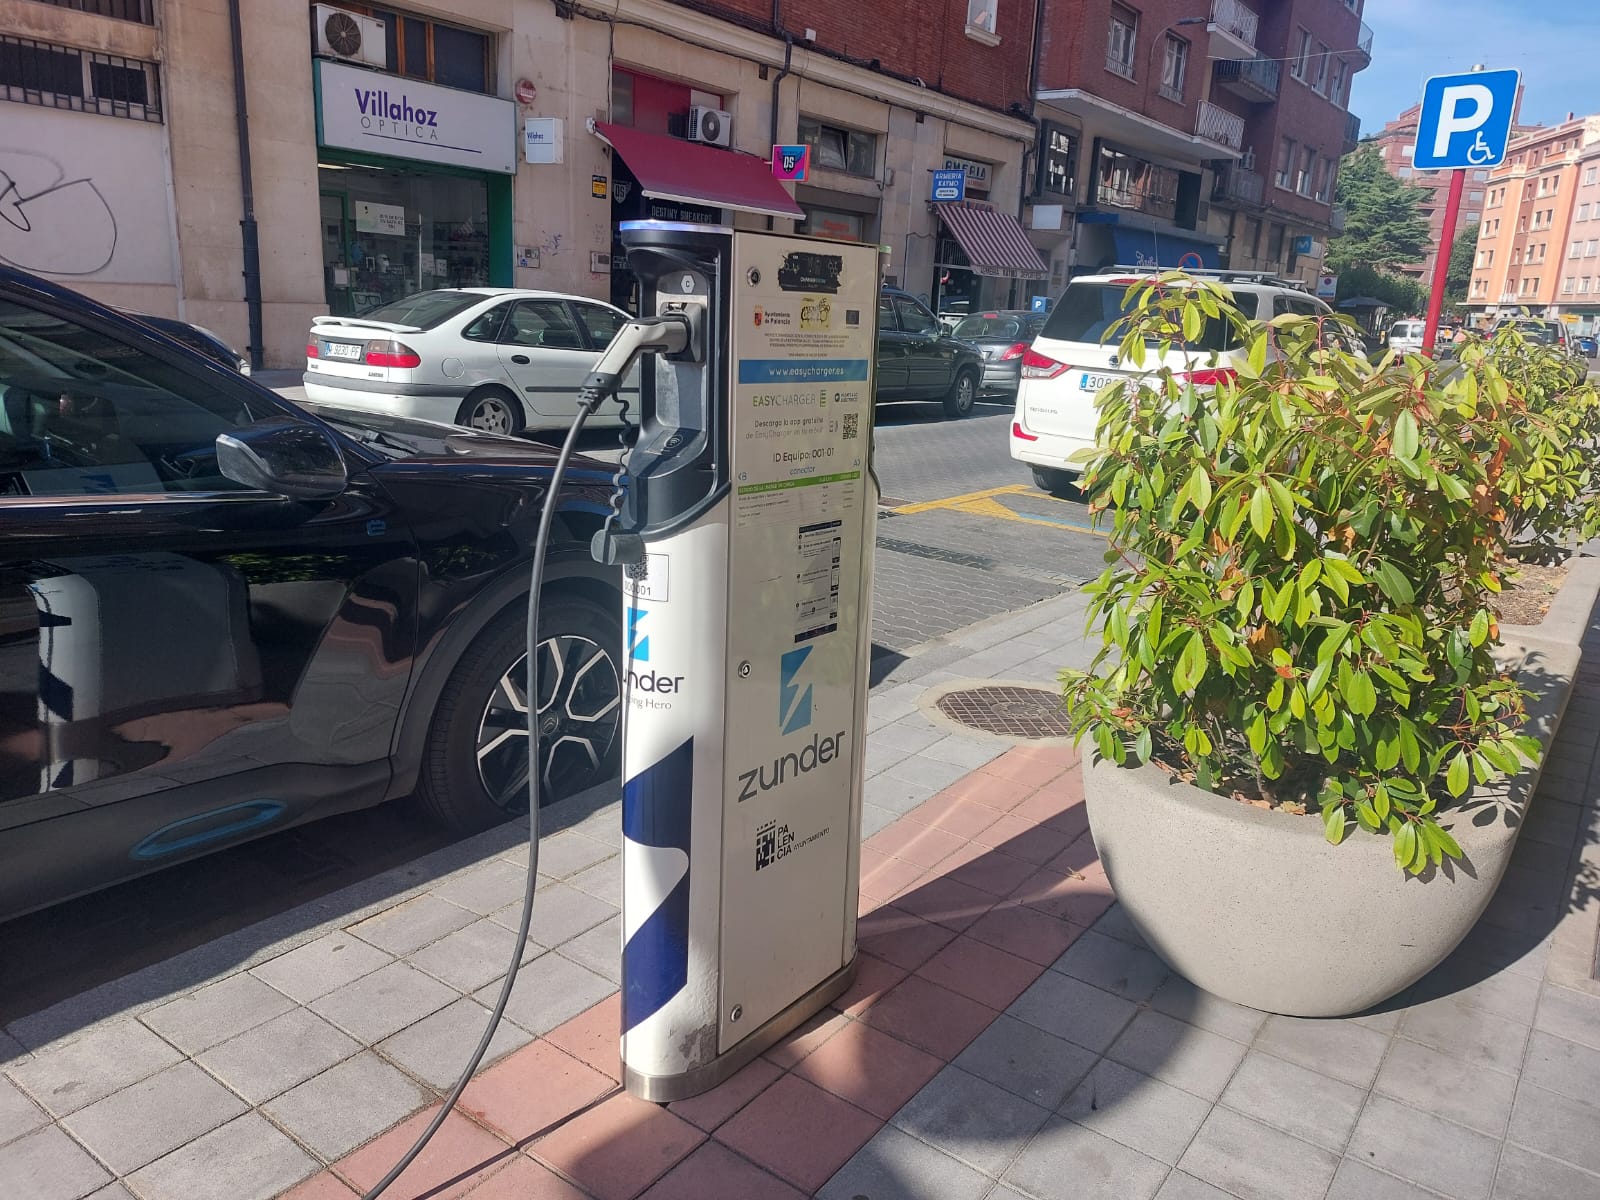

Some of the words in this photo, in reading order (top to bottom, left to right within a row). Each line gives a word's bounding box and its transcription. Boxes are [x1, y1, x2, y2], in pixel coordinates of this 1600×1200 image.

[355, 88, 438, 127] Villahoz
[361, 116, 438, 140] OPTICA
[1433, 85, 1494, 157] P
[784, 155, 795, 169] DS
[935, 172, 962, 180] ARMERIA
[651, 205, 678, 219] DESTINY
[680, 210, 713, 224] SNEAKERS
[768, 365, 845, 378] www.easycharger.es
[752, 393, 816, 407] EASYCHARGER
[645, 697, 672, 710] Hero
[738, 731, 846, 803] zunder
[777, 824, 789, 836] PA
[777, 831, 795, 849] LEN
[776, 845, 792, 860] CIA
